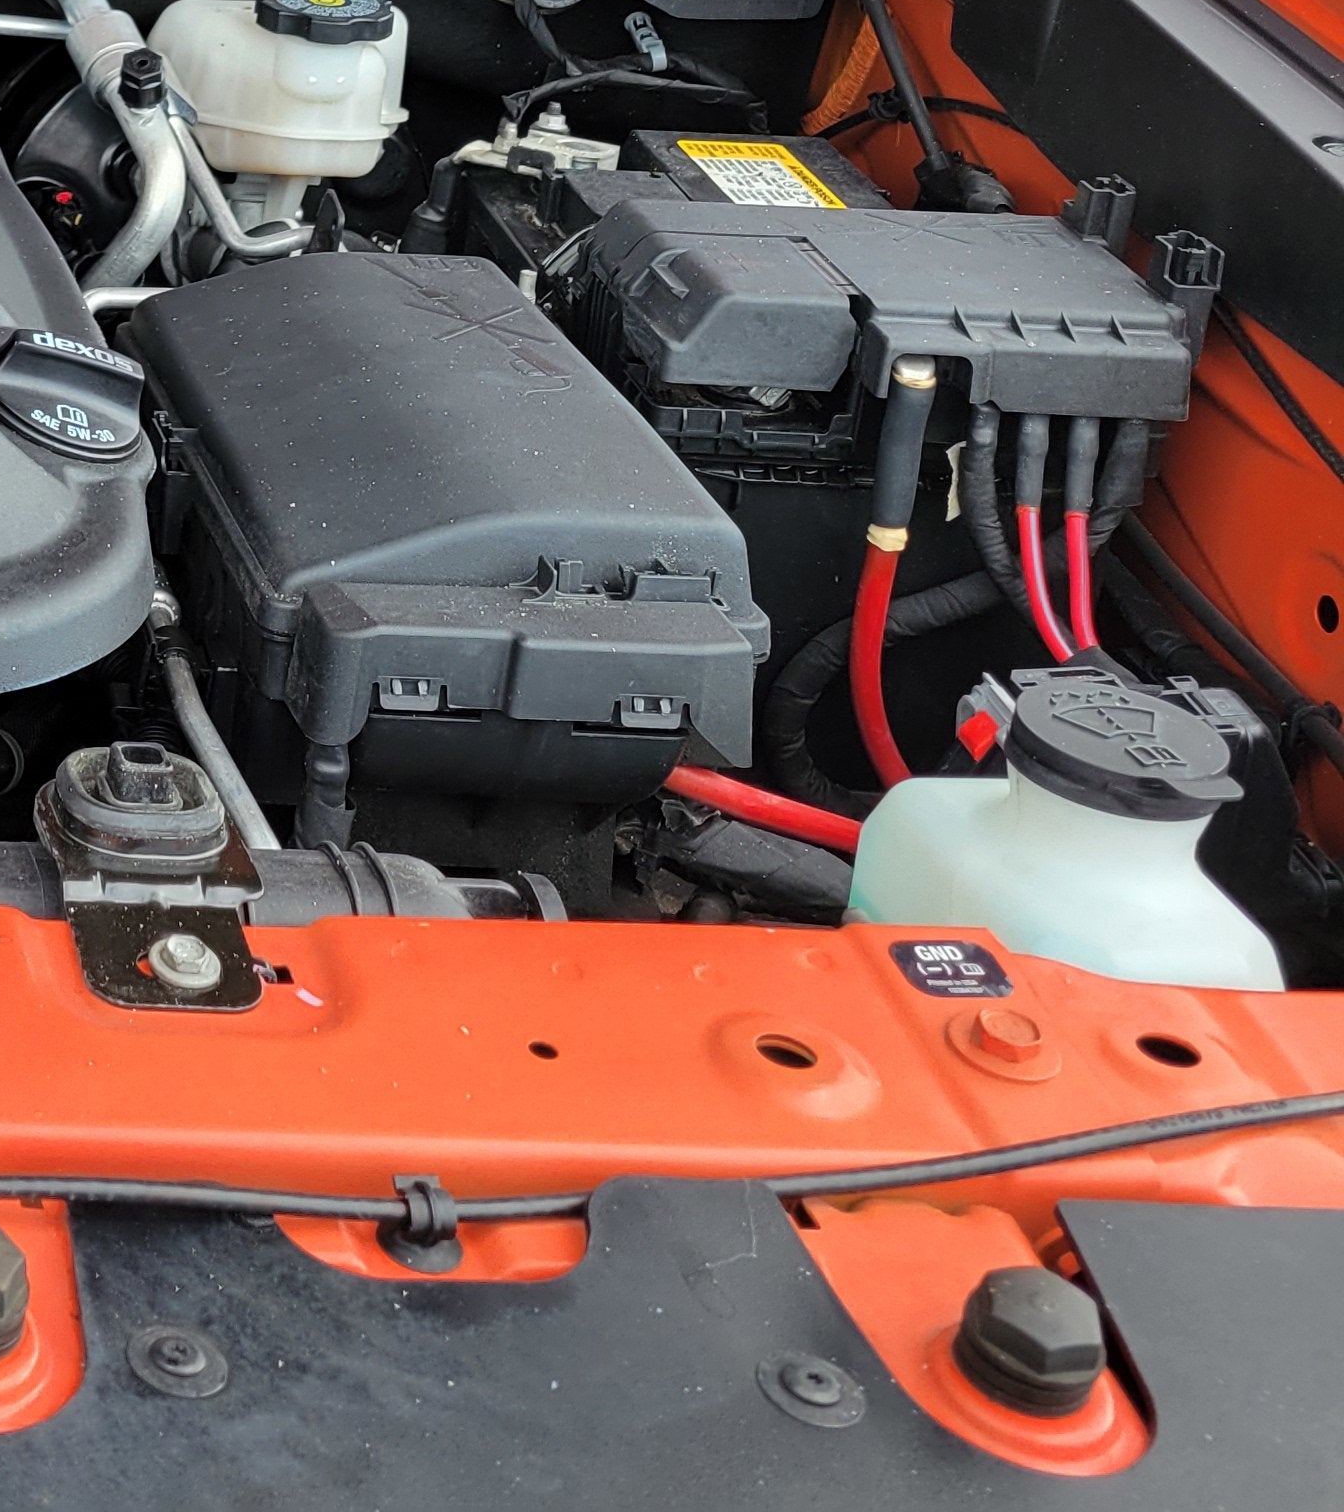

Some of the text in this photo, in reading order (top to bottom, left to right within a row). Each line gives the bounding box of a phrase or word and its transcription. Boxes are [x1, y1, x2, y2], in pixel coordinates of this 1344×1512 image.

[32, 331, 134, 372] dexos
[30, 409, 116, 443] SAE 5W-30
[914, 945, 963, 961] GND
